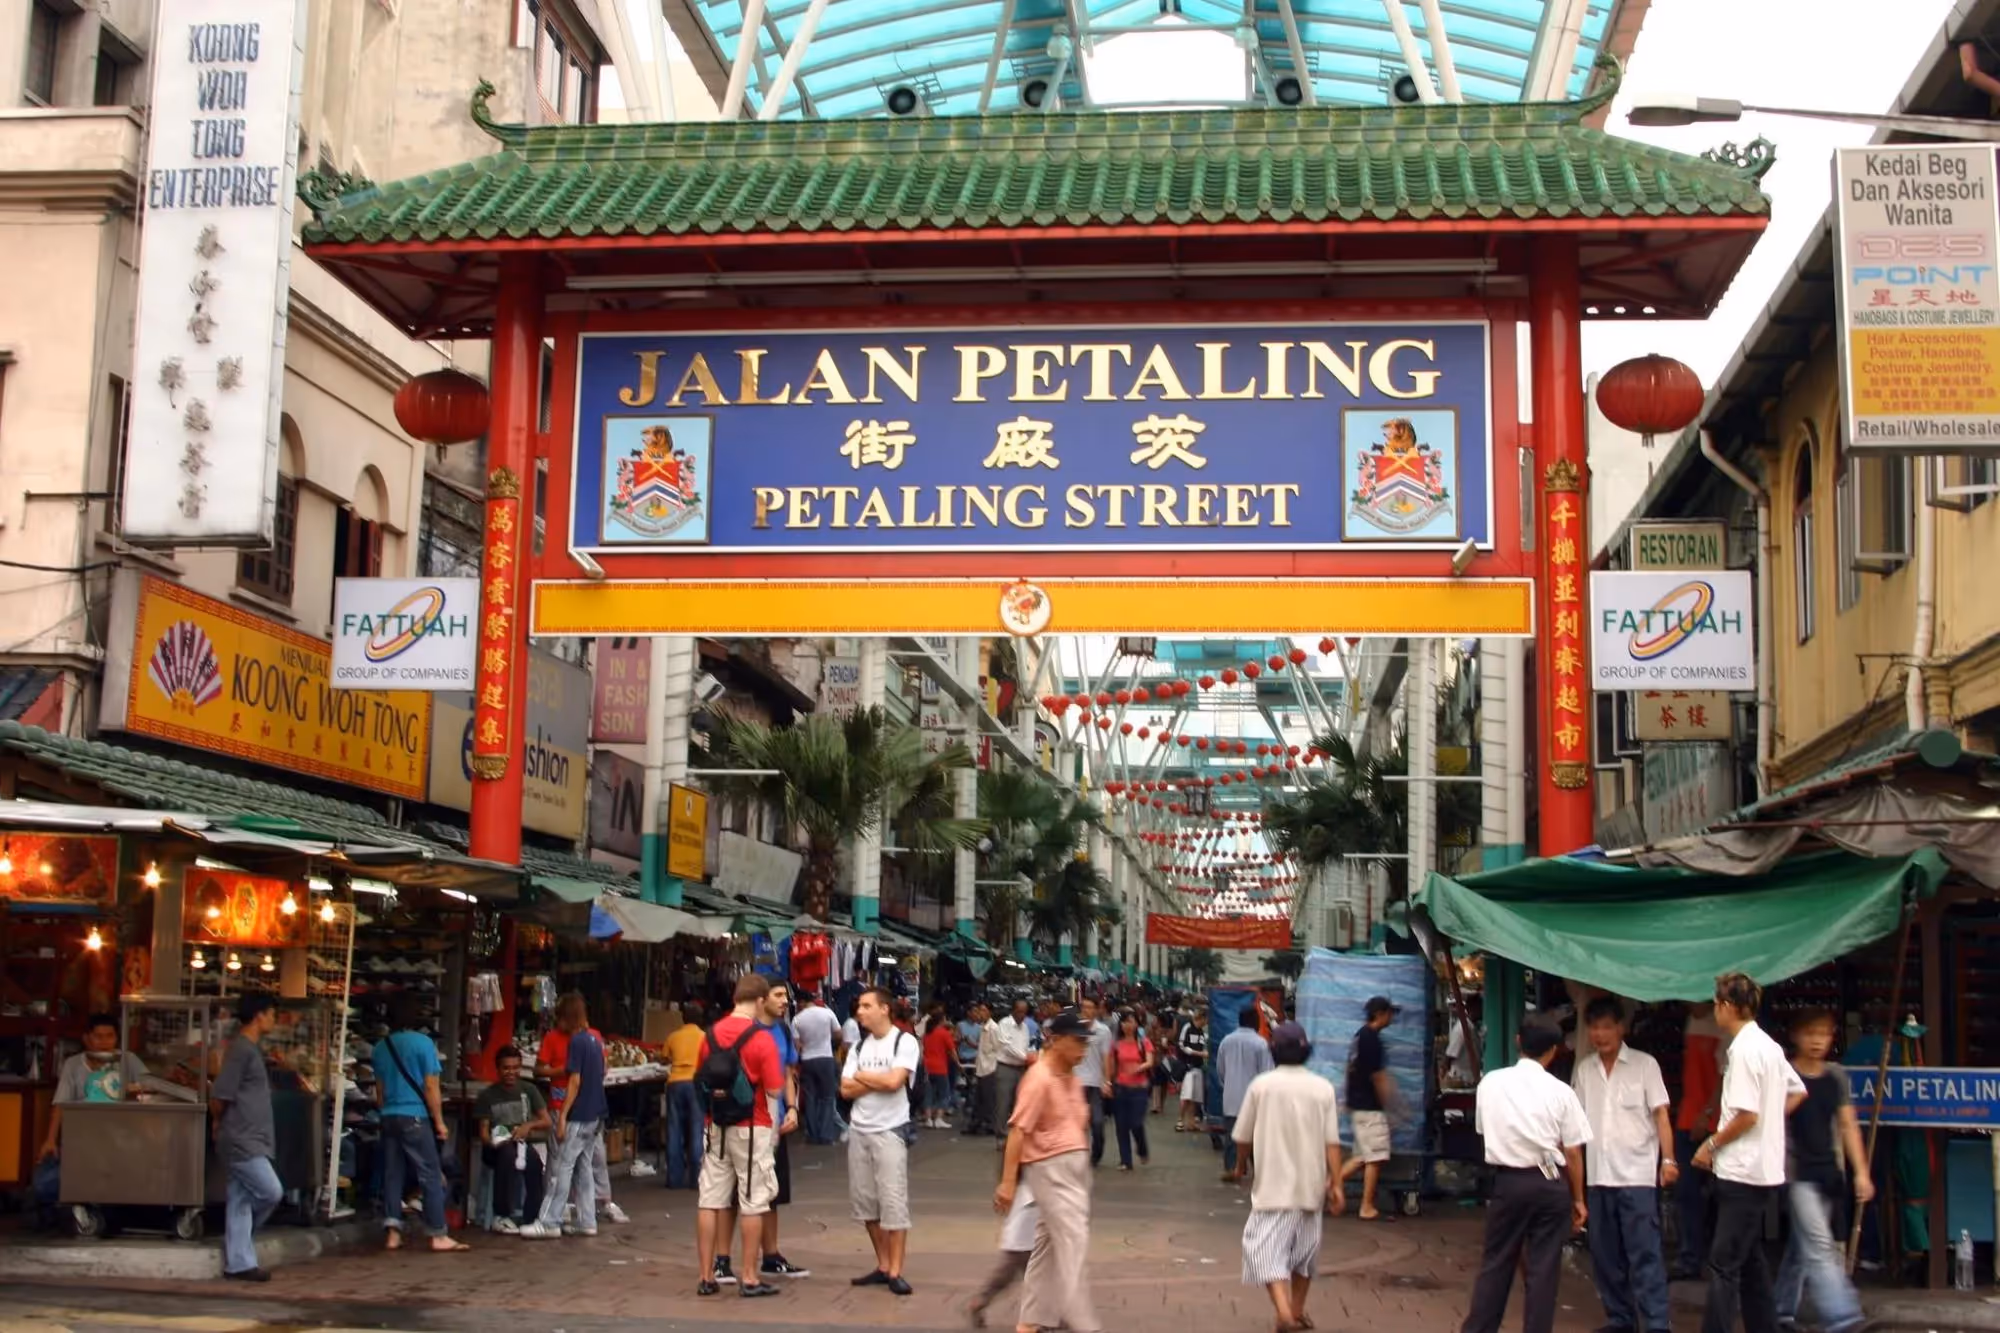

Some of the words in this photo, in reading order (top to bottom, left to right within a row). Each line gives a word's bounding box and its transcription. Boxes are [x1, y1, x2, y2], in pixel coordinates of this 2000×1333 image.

[188, 22, 261, 63] KOONG
[197, 69, 248, 112] WOH
[190, 118, 247, 159] TONG
[1865, 153, 1921, 176] Kedai
[1928, 153, 1967, 181] Beg
[147, 166, 280, 209] ENTERPRISE
[1851, 178, 1889, 201] Dan
[1897, 177, 1985, 201] Aksesori
[1885, 203, 1953, 226] Wanita
[1907, 310, 1946, 324] COSTUME
[1948, 310, 1995, 324] JEWELLERY
[619, 346, 927, 407] JALAN
[953, 339, 1442, 403] PETALING
[1858, 418, 2000, 437] Retail/Wholesale
[752, 485, 1049, 529] PETALING
[1064, 483, 1300, 528] STREET
[1639, 533, 1718, 566] RESTORAN
[342, 614, 468, 637] FATTUAH
[1602, 609, 1742, 634] FATTUAH
[336, 666, 379, 680] GROUP
[381, 667, 397, 680] OF
[400, 667, 470, 680] COMPANIES
[609, 657, 626, 679] IN
[1599, 666, 1646, 679] GROUP
[1649, 667, 1667, 679] OF
[1671, 667, 1747, 680] COMPANIES
[232, 653, 309, 721] KOONG
[319, 683, 367, 738] WOH
[374, 701, 419, 754] TONG
